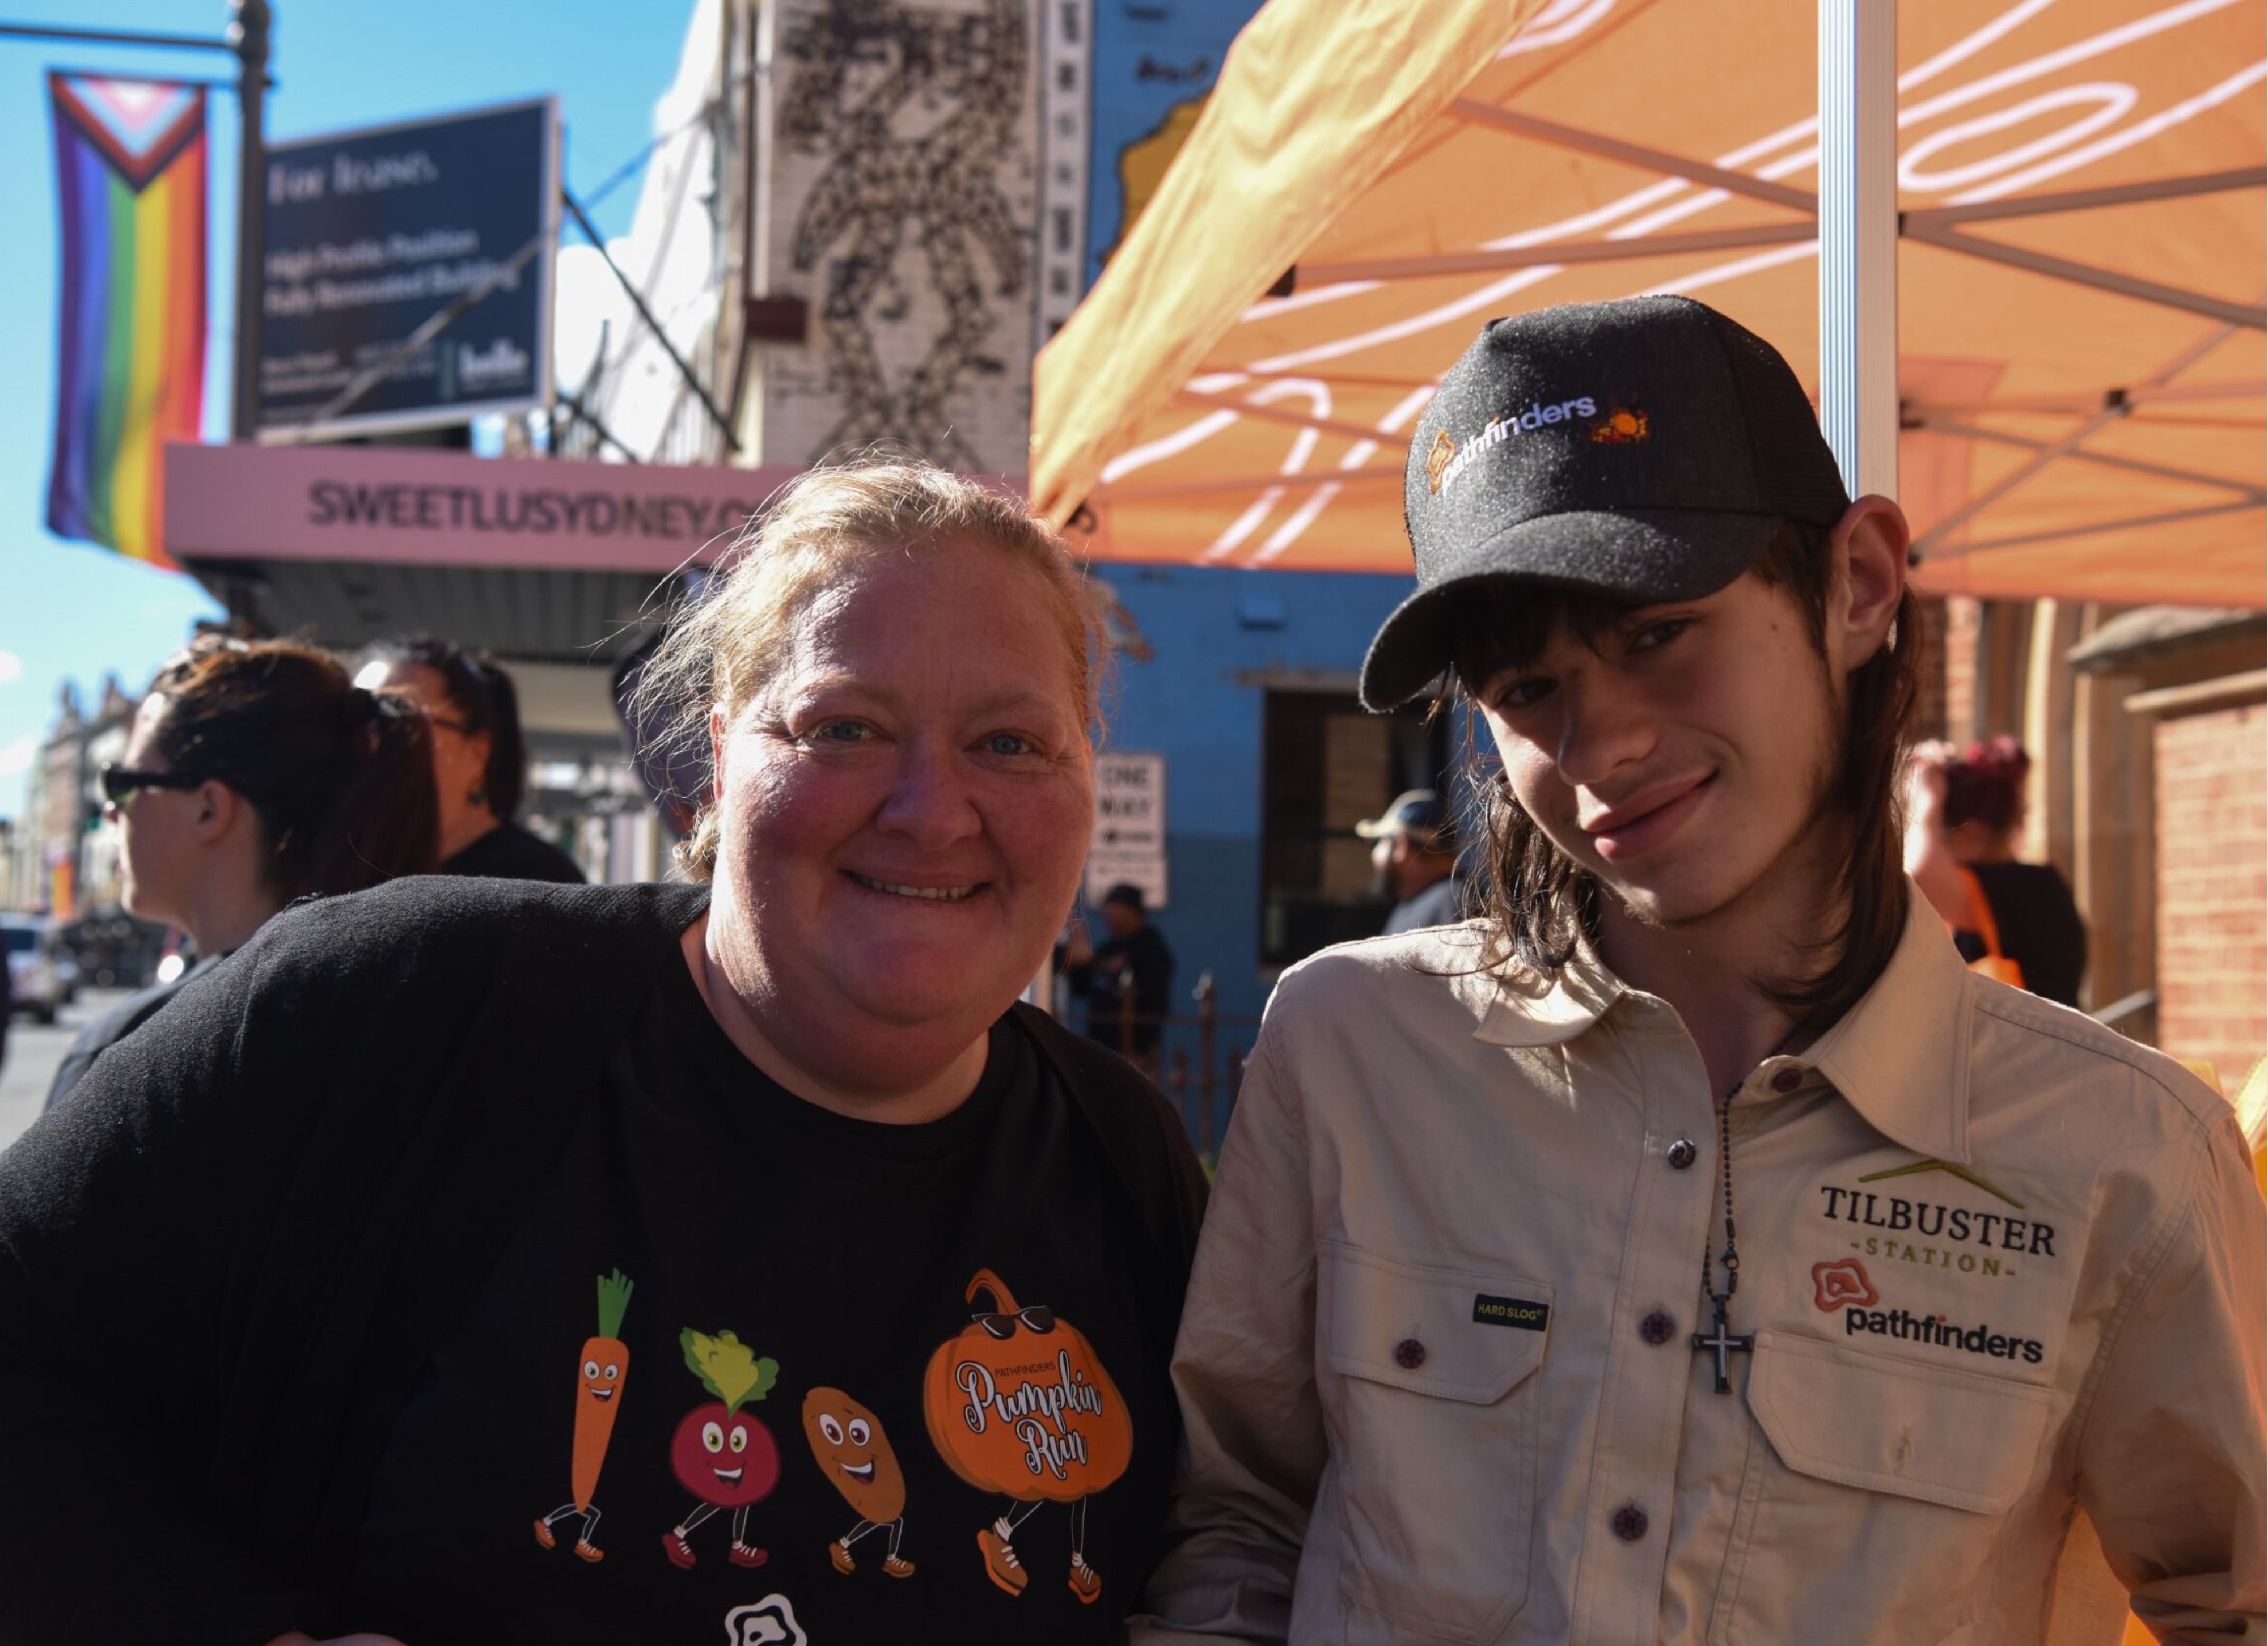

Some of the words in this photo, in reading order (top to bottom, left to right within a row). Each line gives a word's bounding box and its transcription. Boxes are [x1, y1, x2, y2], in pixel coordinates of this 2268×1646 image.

[1442, 396, 1598, 498] pathfinders
[1821, 1186, 2056, 1257] TILBUSTER
[1478, 1304, 1505, 1317] HARD
[1846, 1306, 2044, 1363] pathfinders
[955, 1348, 1102, 1434] Pumpkin
[994, 1361, 1056, 1377] PATHFINDERS
[1015, 1417, 1087, 1480] Run
